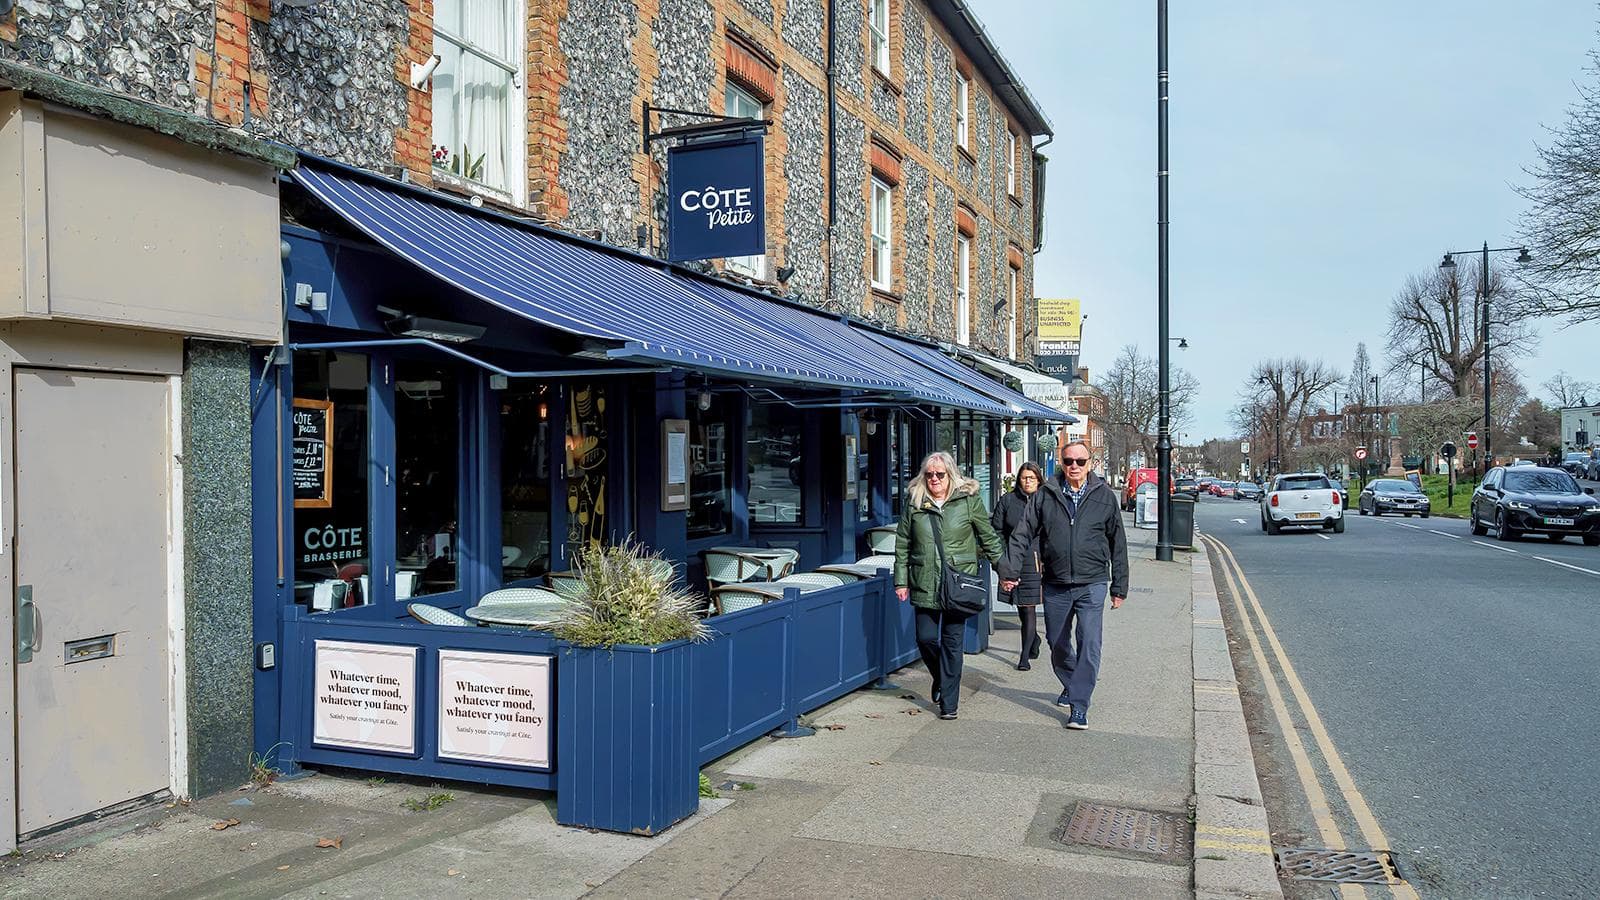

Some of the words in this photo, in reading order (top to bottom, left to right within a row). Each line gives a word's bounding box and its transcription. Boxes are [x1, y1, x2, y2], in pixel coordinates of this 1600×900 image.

[680, 186, 752, 211] CÔTE
[706, 208, 754, 230] Petite
[1040, 342, 1079, 350] franklin
[293, 412, 312, 425] CÔTE
[304, 523, 363, 550] CÔTE
[303, 549, 363, 563] BRASSERIE
[329, 669, 375, 684] Whatever
[376, 674, 401, 687] time,
[327, 682, 370, 696] whatever
[371, 687, 402, 700] mood,
[456, 680, 506, 695] Whatever
[507, 684, 534, 698] time,
[319, 695, 363, 708] whatever
[363, 701, 382, 710] you
[383, 699, 410, 714] fancy
[454, 694, 501, 708] whatever
[502, 699, 536, 713] mood,
[446, 706, 493, 720] whatever
[494, 713, 514, 723] you
[515, 711, 544, 727] fancy
[456, 726, 474, 735] Satisfy
